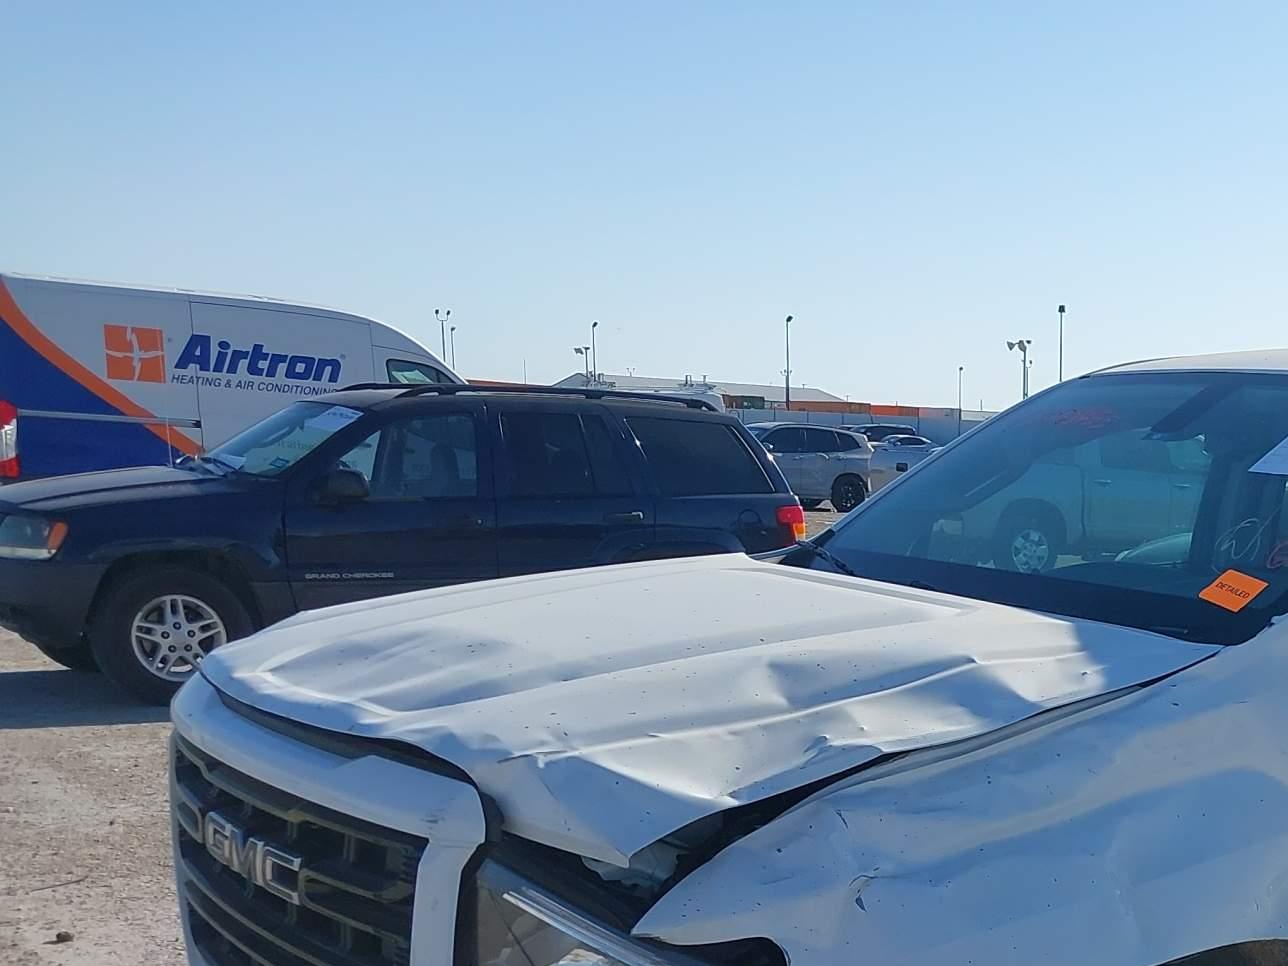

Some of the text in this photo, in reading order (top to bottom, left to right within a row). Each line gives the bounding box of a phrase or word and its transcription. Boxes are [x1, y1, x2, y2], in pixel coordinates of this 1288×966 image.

[171, 373, 222, 388] HEATING
[224, 380, 232, 388] &
[235, 381, 255, 391] AIR
[174, 333, 342, 384] Airtron
[204, 811, 302, 906] GMC
